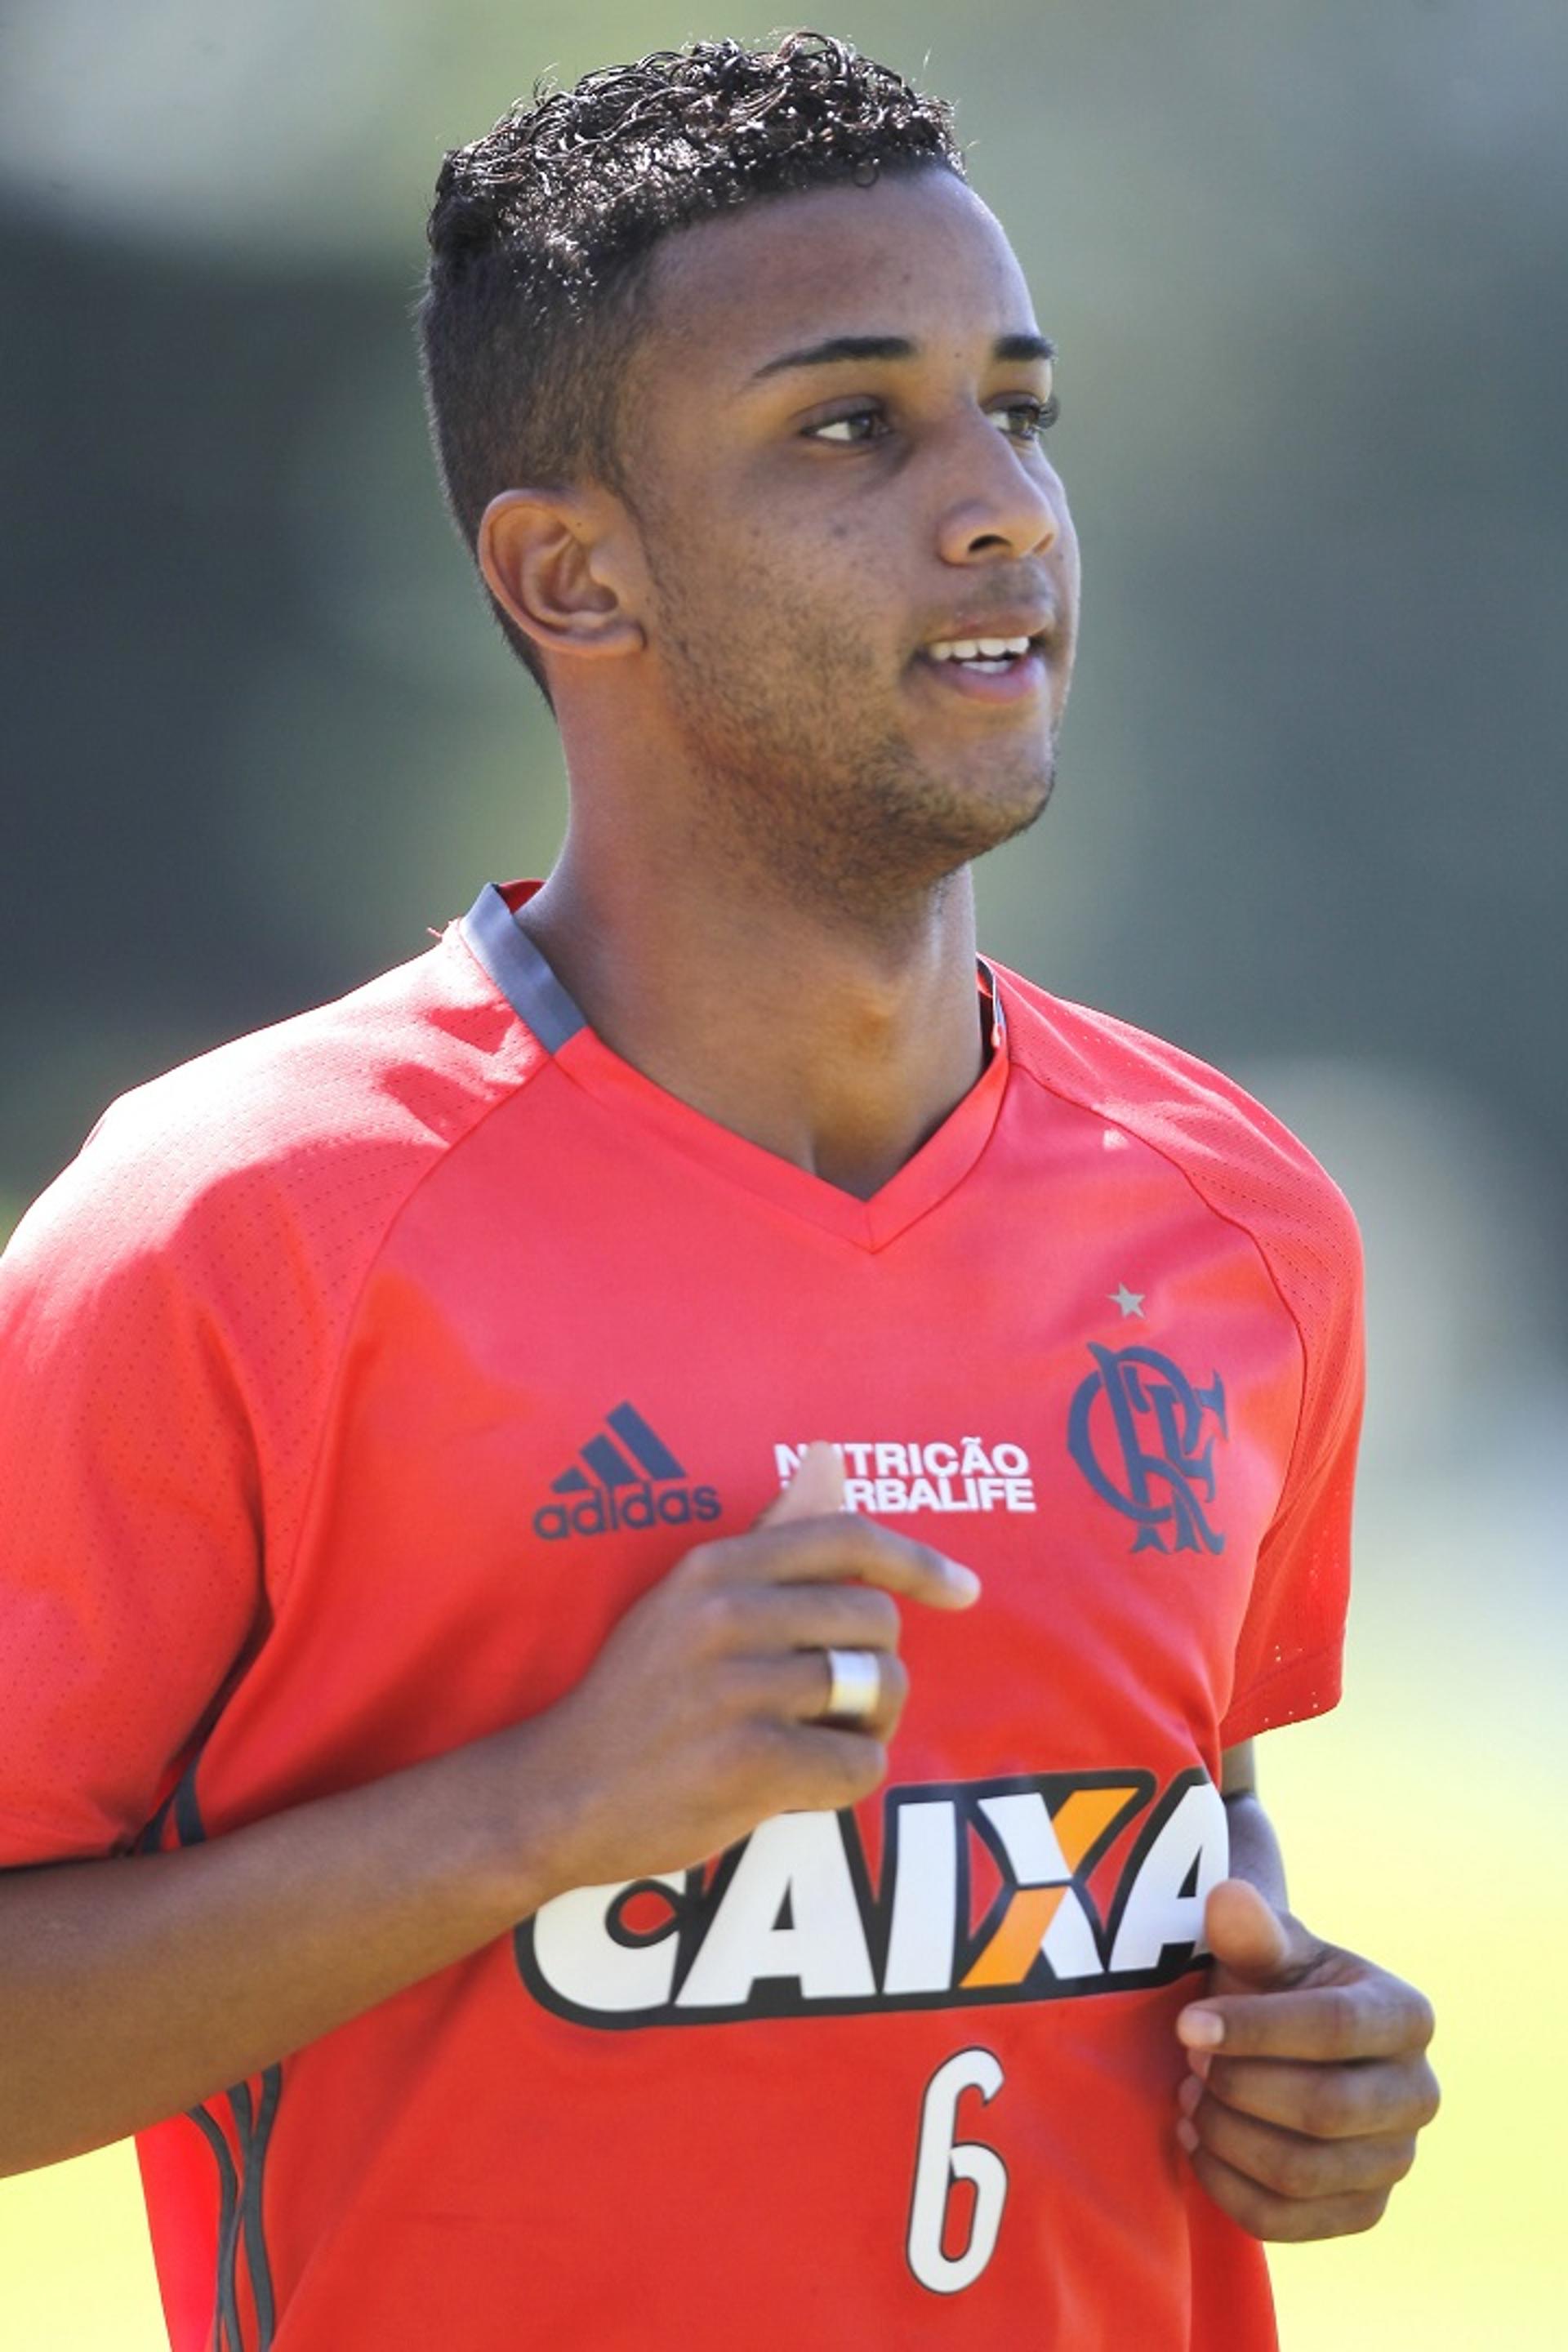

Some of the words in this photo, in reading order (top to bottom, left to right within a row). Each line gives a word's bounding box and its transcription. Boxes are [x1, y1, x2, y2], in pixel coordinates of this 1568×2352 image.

[533, 1479, 723, 1541] adidas
[780, 1478, 1036, 1512] RBALIFE
[529, 1782, 1230, 2014] CAIXA
[906, 2046, 1008, 2296] 6
